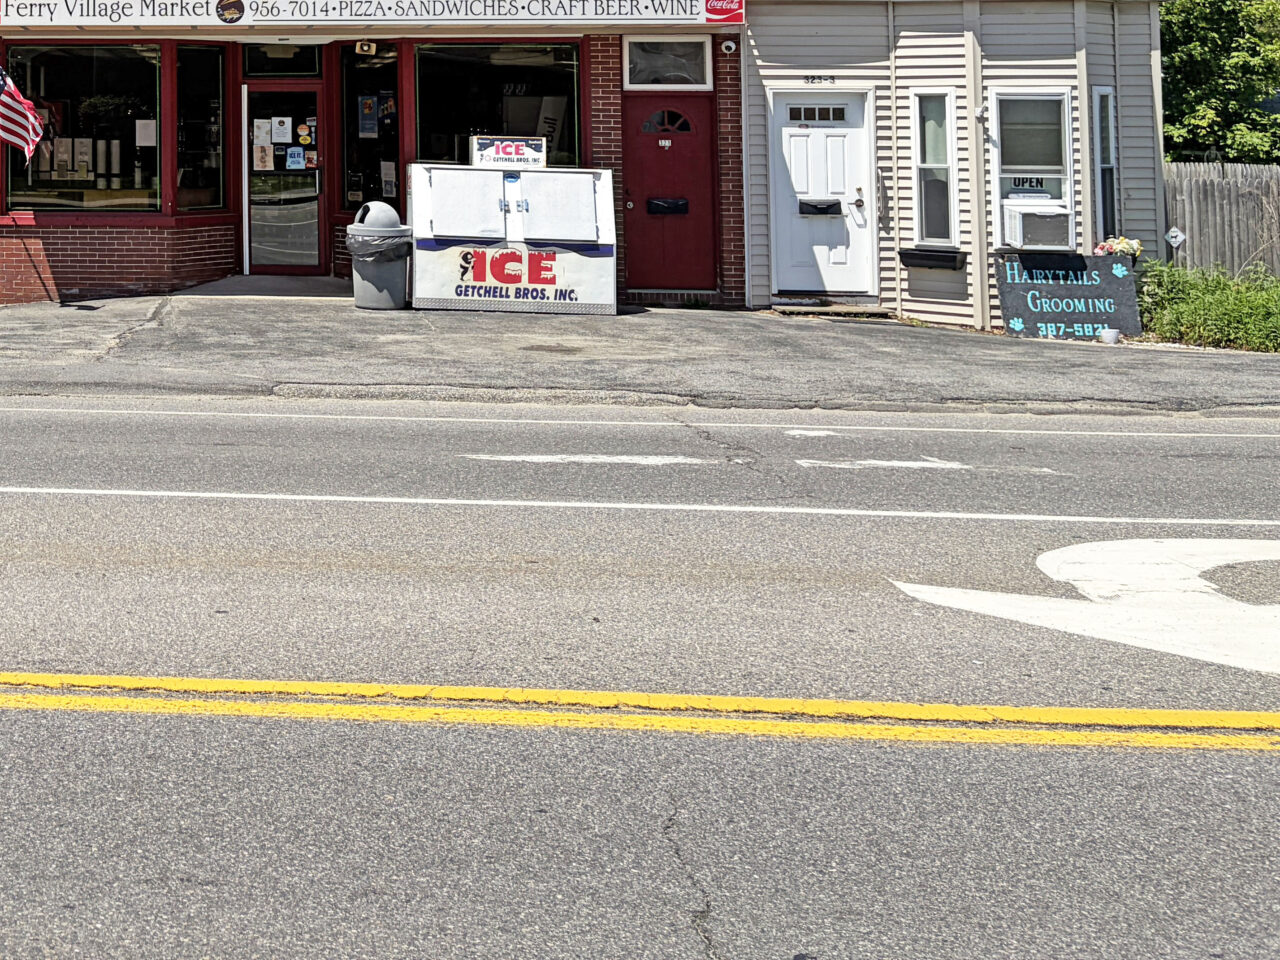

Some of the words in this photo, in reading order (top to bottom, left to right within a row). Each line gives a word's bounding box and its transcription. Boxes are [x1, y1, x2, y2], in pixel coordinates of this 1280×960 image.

[249, 0, 330, 17] 956-7014
[338, 0, 387, 17] PIZZA
[394, 0, 519, 17] SANDWICHES
[527, 0, 590, 16] CRAFT
[803, 75, 836, 84] 323-3
[494, 142, 526, 156] ICE
[1013, 177, 1044, 188] OPEN
[473, 247, 557, 285] ICE
[454, 285, 511, 299] GETCHELL
[514, 288, 550, 300] BROS.
[554, 289, 578, 301] INC.
[1027, 290, 1115, 313] GROOMING
